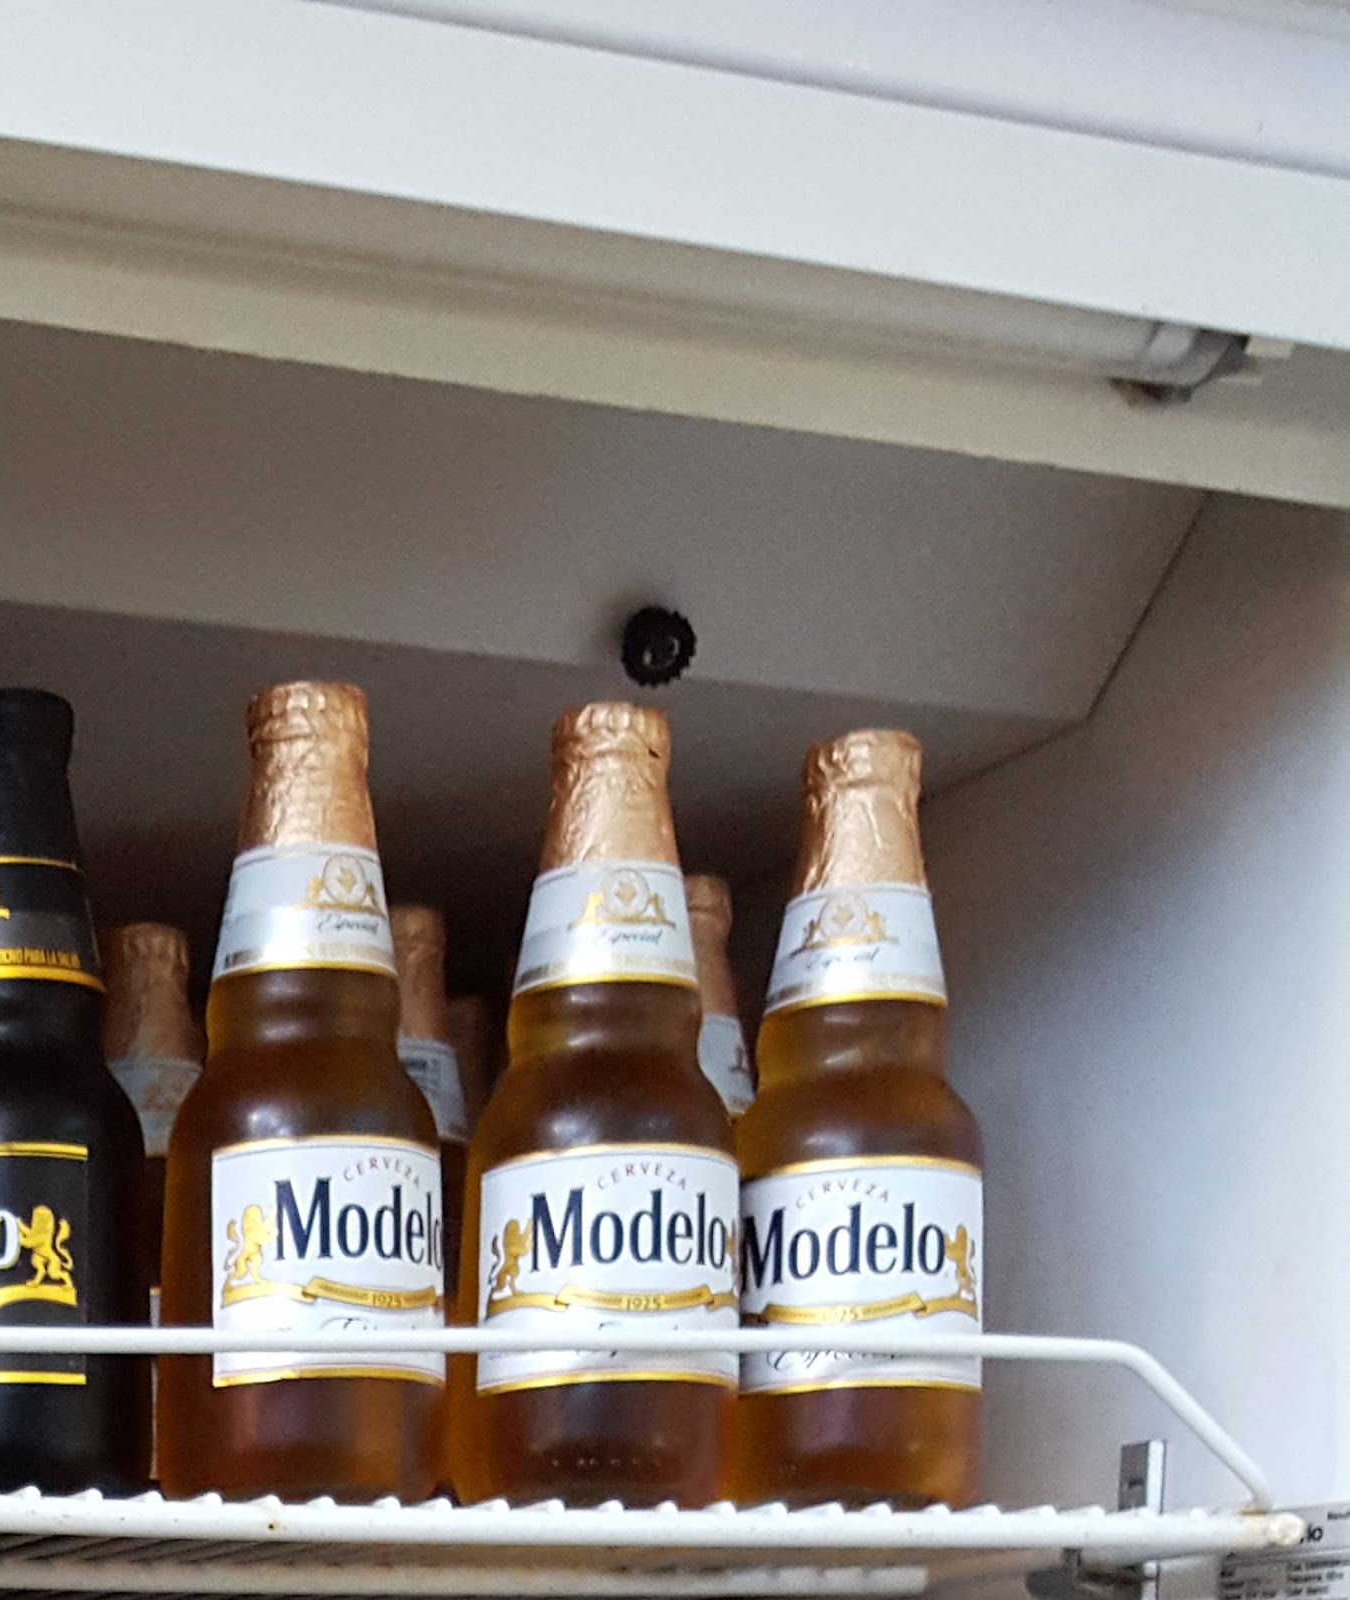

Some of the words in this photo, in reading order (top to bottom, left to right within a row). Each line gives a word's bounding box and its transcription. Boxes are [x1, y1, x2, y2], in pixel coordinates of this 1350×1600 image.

[343, 1155, 420, 1188] CERVEZA
[597, 1160, 688, 1192] CERVEZA
[796, 1178, 891, 1211] CERVEZA
[529, 1186, 728, 1275] Modelo
[741, 1201, 947, 1296] Modelo
[372, 1294, 403, 1309] 1925
[624, 1294, 663, 1311] 1925
